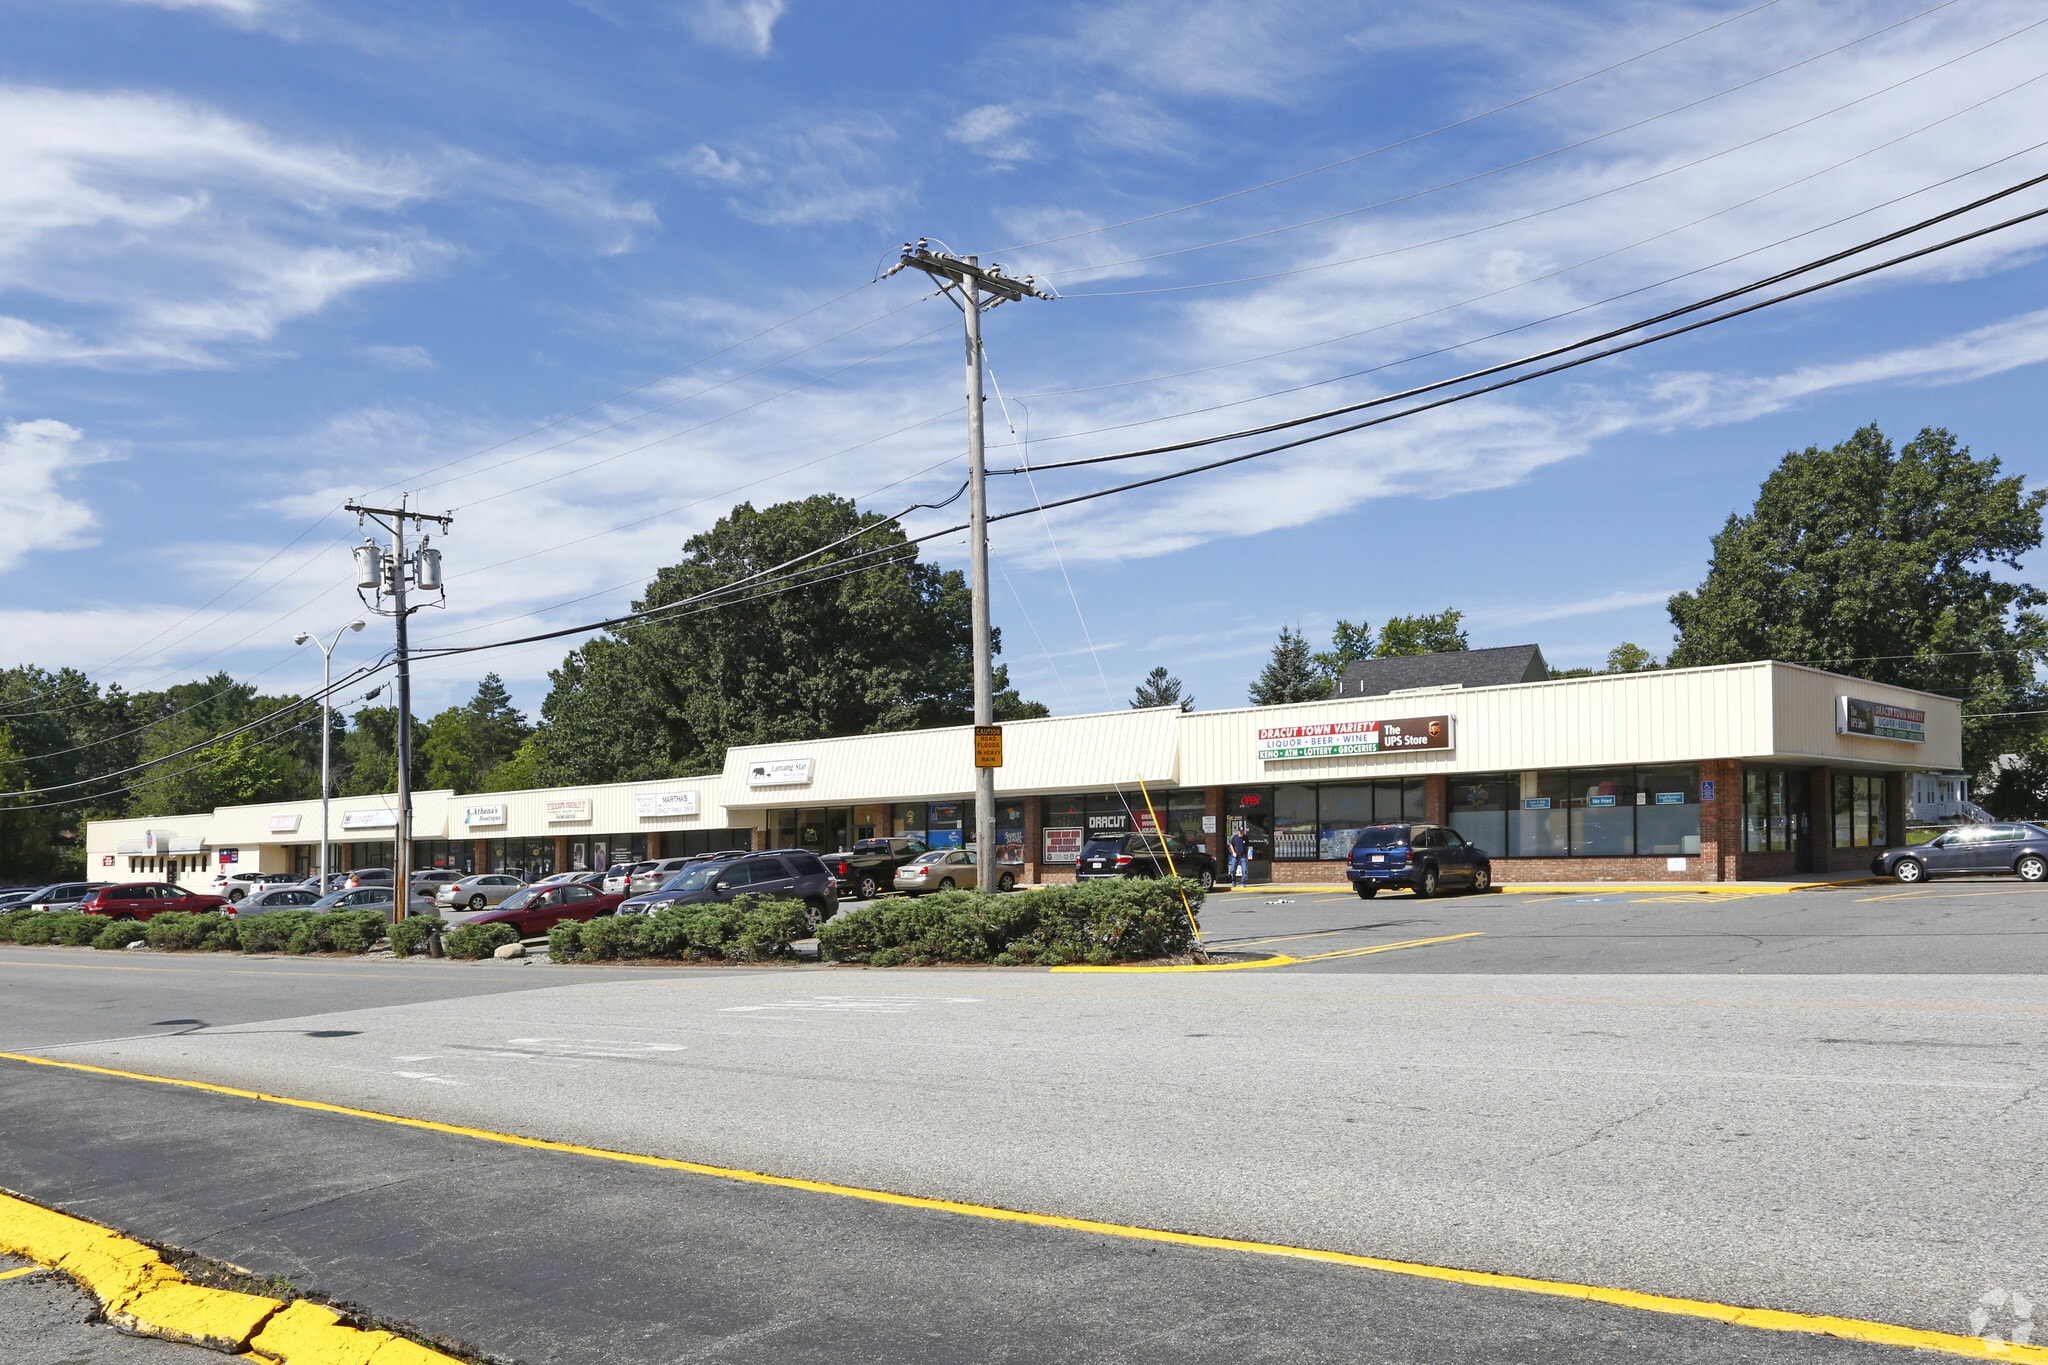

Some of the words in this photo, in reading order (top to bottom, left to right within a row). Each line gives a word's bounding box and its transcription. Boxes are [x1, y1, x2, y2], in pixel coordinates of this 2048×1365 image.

[976, 728, 1000, 736] CAUTION
[1260, 727, 1300, 739] DRACUT
[1301, 724, 1331, 736] TOWN
[1333, 720, 1377, 734] VARIETY
[1384, 725, 1401, 736] The
[1267, 737, 1302, 749] LIQUOR
[1311, 735, 1333, 745] BEER
[1343, 733, 1368, 743] WINE
[1384, 735, 1402, 747] UPS
[1404, 734, 1429, 746] Store
[1259, 749, 1279, 759] KENO
[1284, 748, 1299, 757] ATM
[1304, 745, 1332, 757] LOTTERY
[1338, 743, 1377, 754] GROCERIES
[1240, 795, 1260, 805] OPEN
[472, 806, 498, 815] Athena's
[1089, 815, 1126, 829] DRACUT
